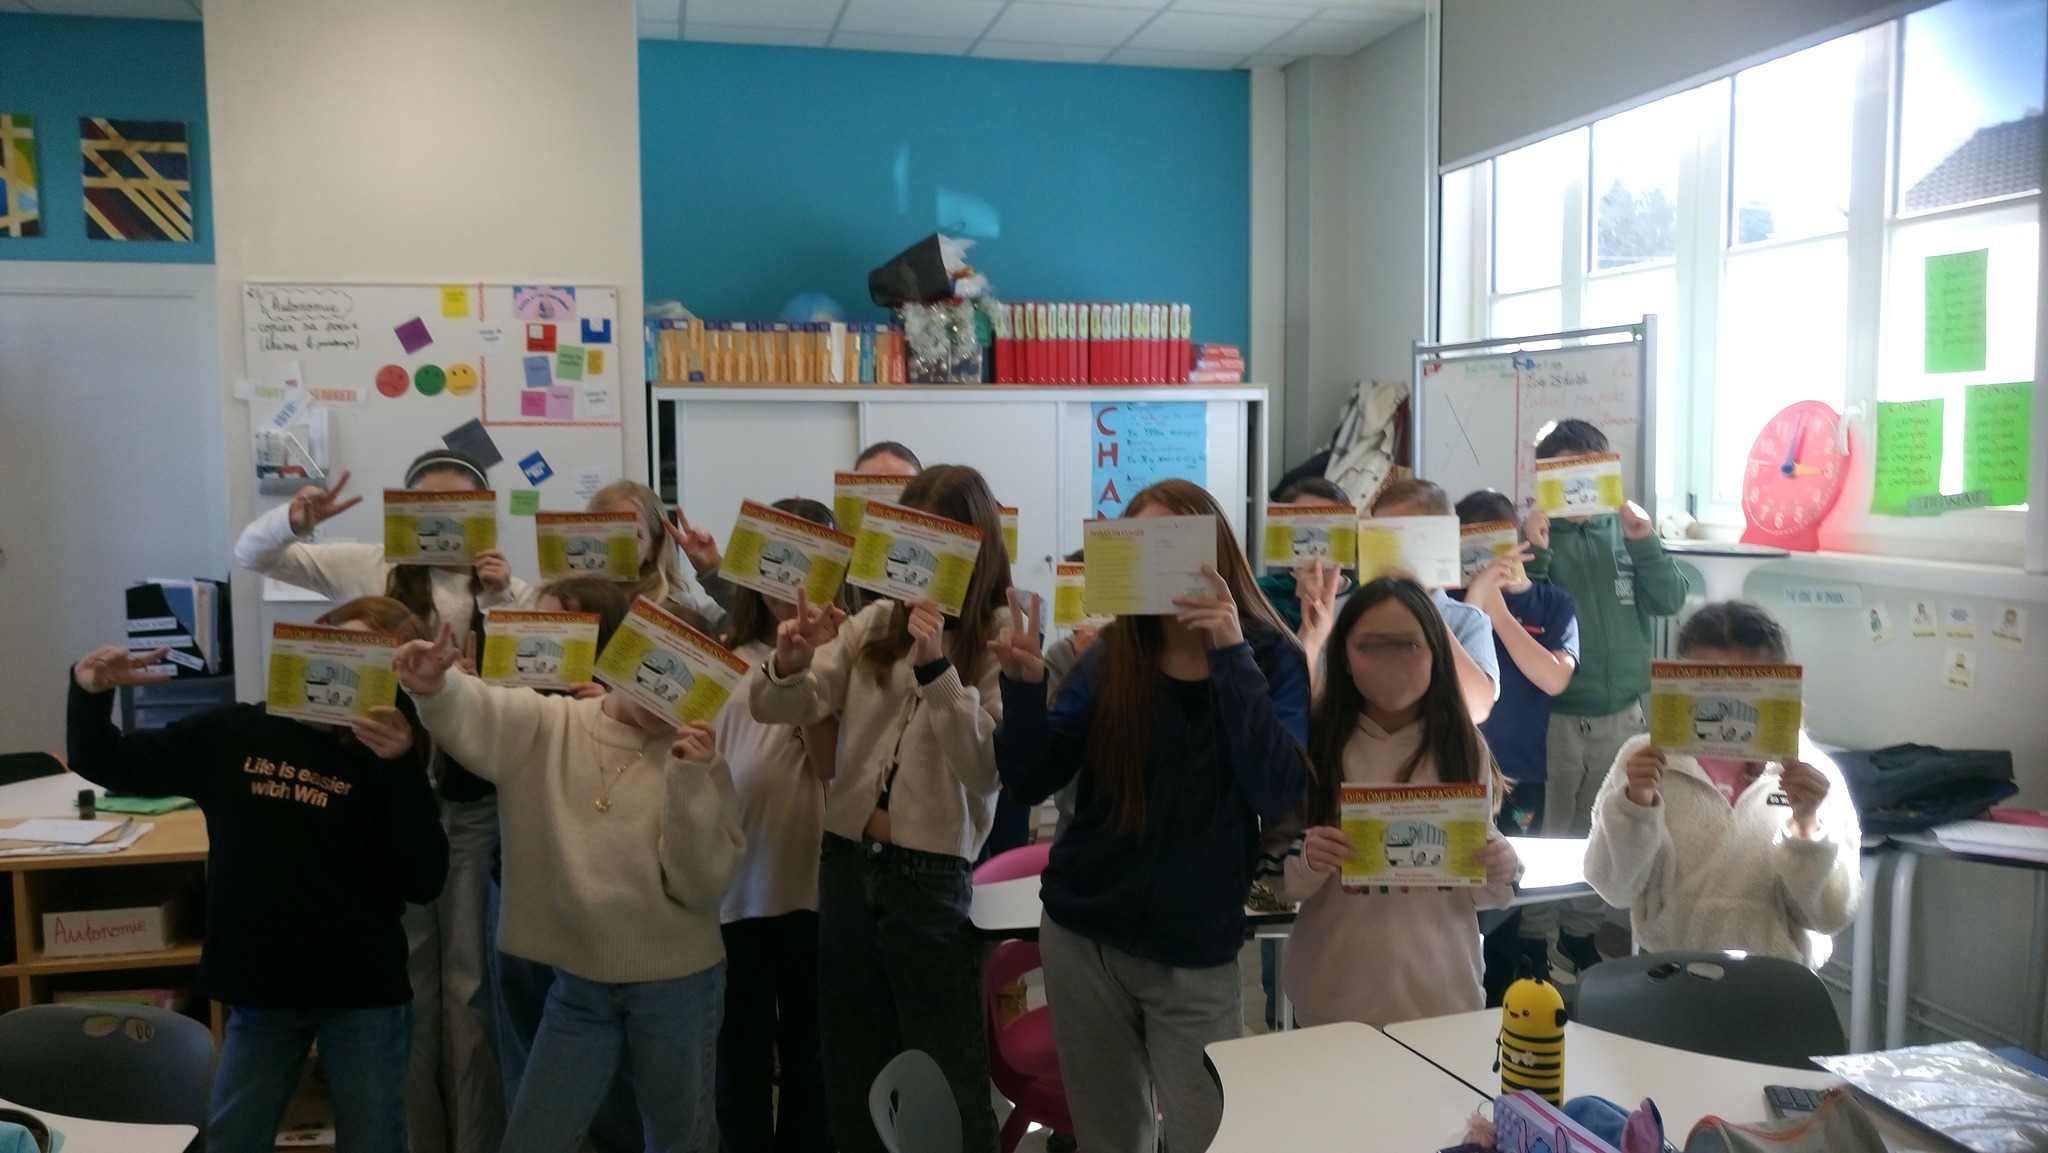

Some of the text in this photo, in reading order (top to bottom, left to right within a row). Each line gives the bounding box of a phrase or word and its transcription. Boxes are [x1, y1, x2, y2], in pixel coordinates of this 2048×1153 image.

[243, 756, 353, 796] Life is easier
[251, 779, 328, 808] with Wifi
[55, 916, 146, 944] Autonomie
